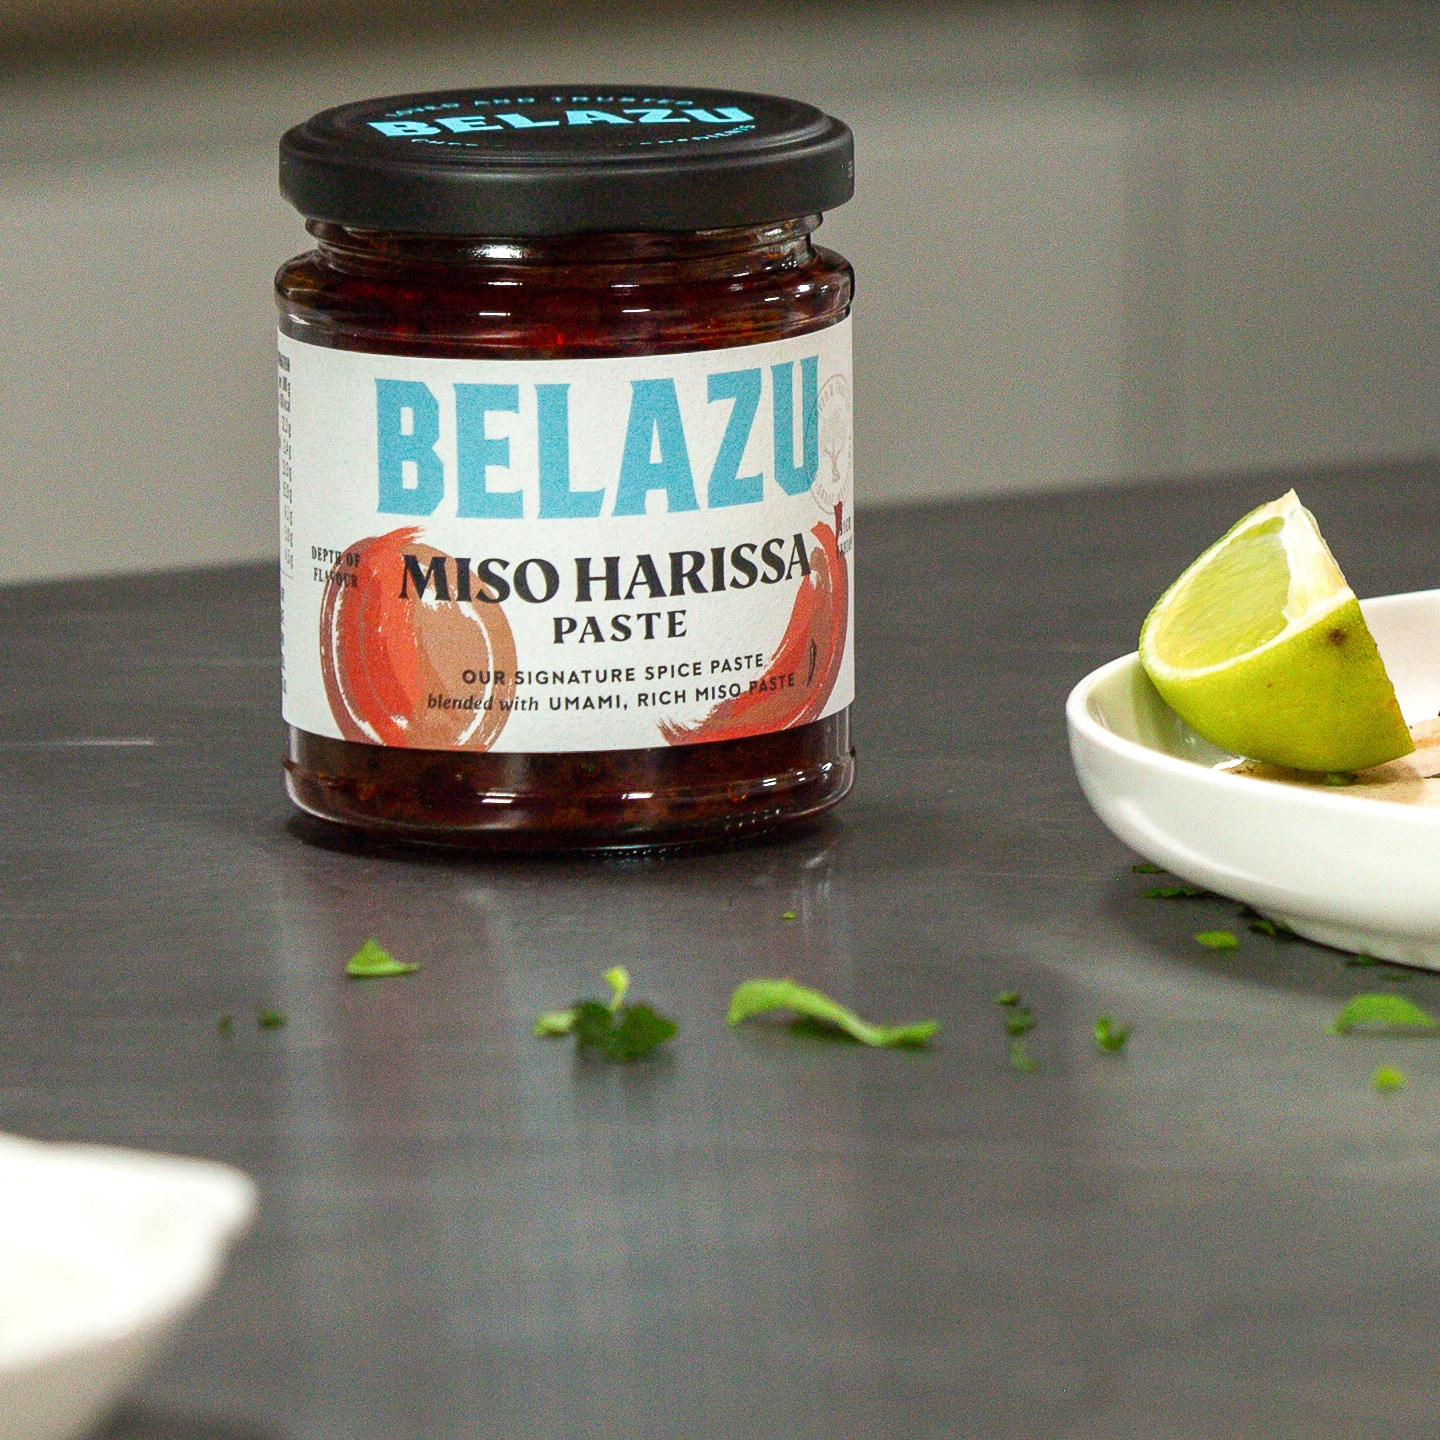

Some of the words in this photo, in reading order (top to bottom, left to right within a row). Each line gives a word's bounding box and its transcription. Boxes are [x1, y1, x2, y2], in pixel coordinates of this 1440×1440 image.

[366, 107, 755, 136] BELAZU
[375, 355, 820, 520] BELAZU
[311, 545, 341, 565] DEPTH
[346, 553, 360, 568] OF
[400, 554, 560, 604] MISO
[575, 533, 811, 602] HARISSA
[313, 567, 358, 588] FLAVOUR
[552, 609, 688, 645] PASTE
[462, 669, 505, 685] OUR
[514, 668, 635, 685] SIGNATURE
[644, 662, 702, 680] SPICE
[710, 653, 764, 675] PASTE
[427, 693, 494, 711] blended
[499, 696, 539, 712] with
[549, 694, 628, 711] UMAMI,
[637, 689, 686, 707] RICH
[695, 683, 741, 702] MISO
[749, 673, 795, 695] PASTE
